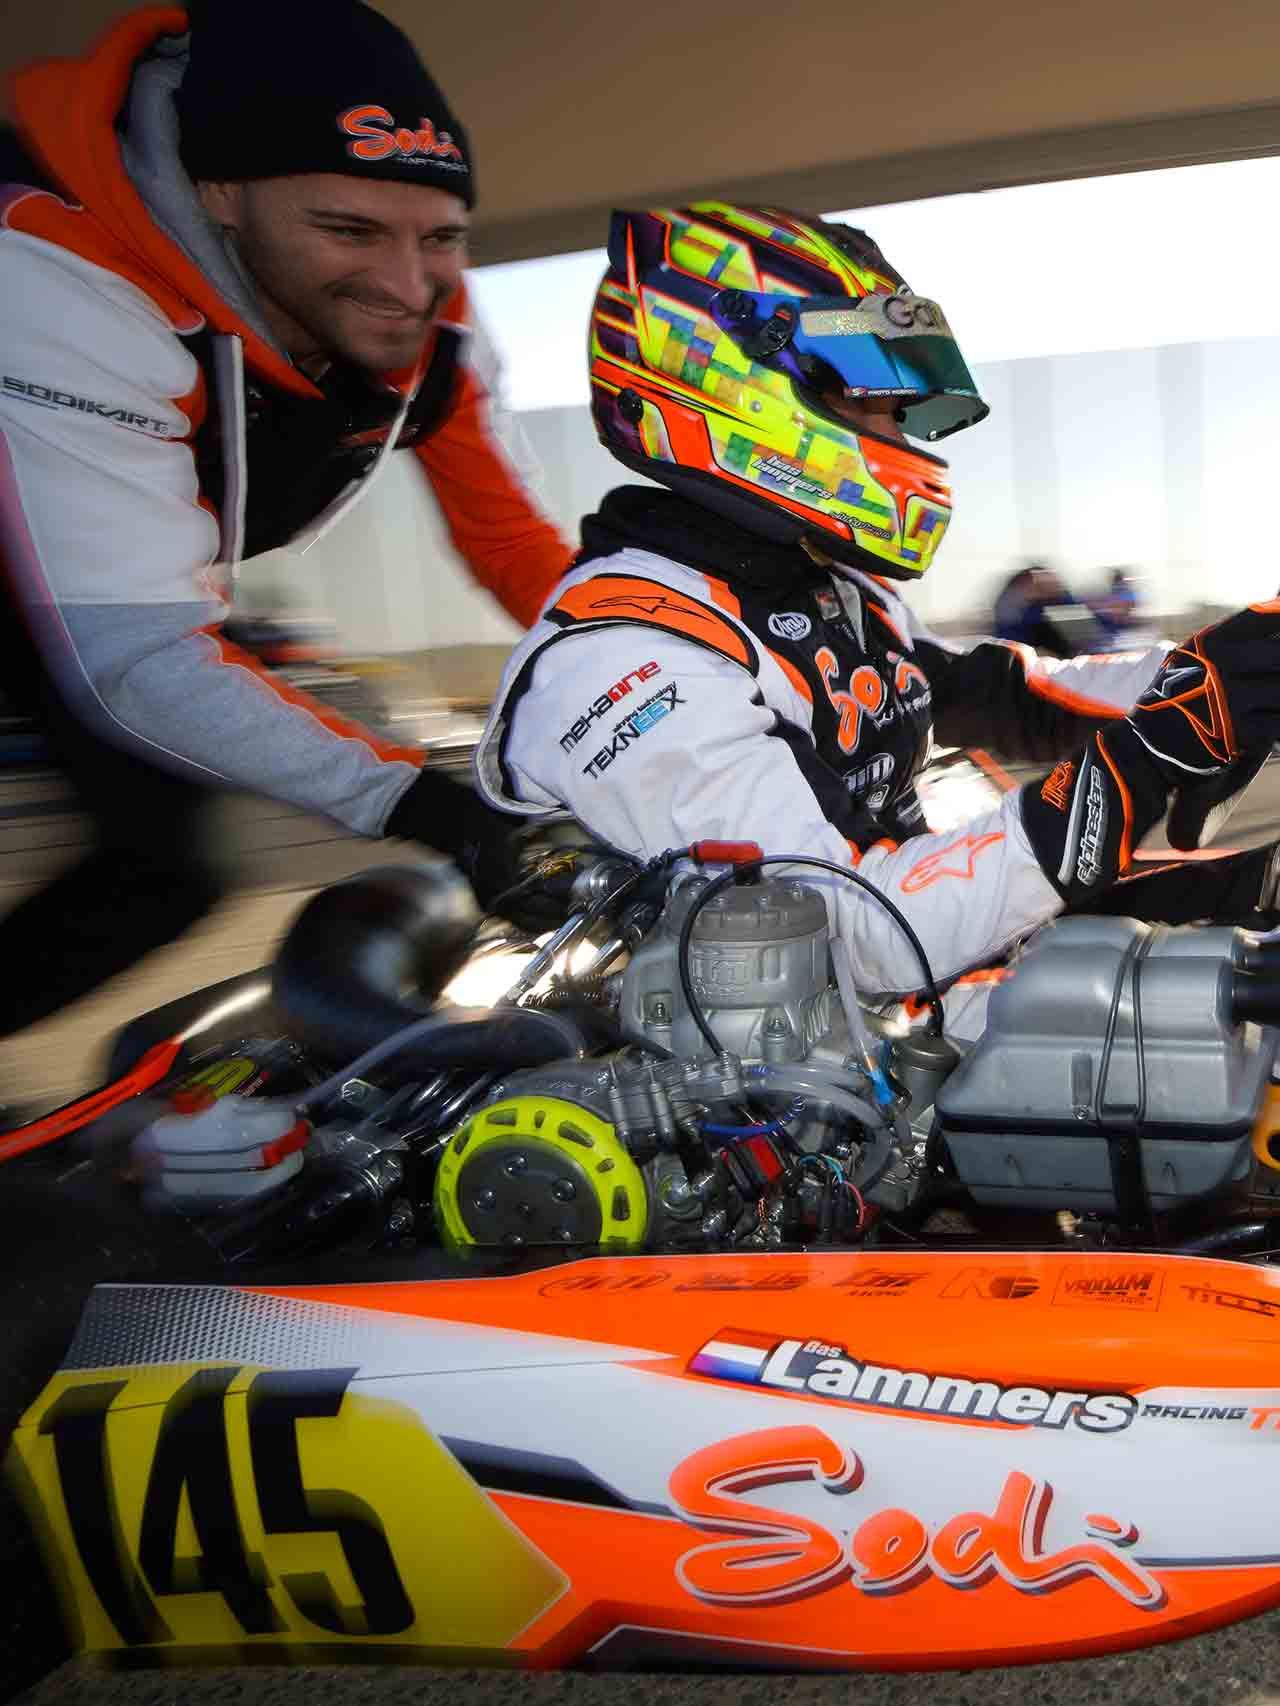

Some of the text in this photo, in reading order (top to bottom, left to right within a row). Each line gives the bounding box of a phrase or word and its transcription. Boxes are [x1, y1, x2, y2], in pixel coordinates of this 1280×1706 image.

[340, 105, 464, 161] Sodi
[2, 376, 169, 434] SODIKART
[583, 681, 687, 779] TEKNEEX
[1077, 765, 1103, 882] alpinestars
[761, 1340, 1140, 1431] Lammers
[1141, 1404, 1248, 1420] RACING
[38, 1367, 416, 1646] 145
[668, 1425, 1170, 1611] Sodi
